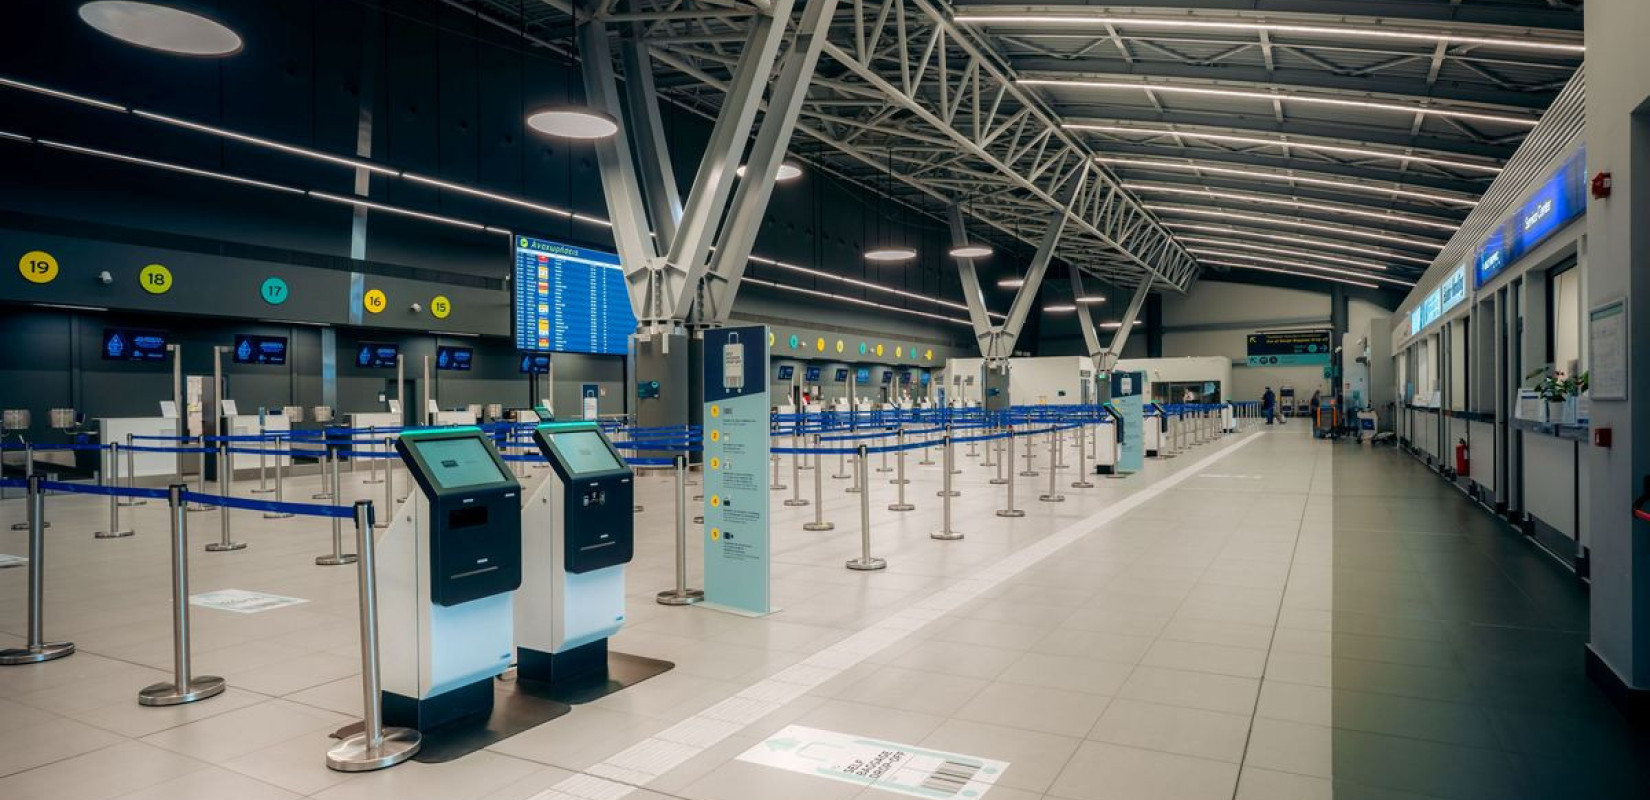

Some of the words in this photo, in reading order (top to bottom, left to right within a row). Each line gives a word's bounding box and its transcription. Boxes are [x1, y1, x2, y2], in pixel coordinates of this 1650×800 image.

[29, 260, 49, 274] 19
[147, 273, 166, 286] 18
[268, 285, 282, 297] 17
[369, 296, 382, 307] 16
[436, 302, 446, 312] 15
